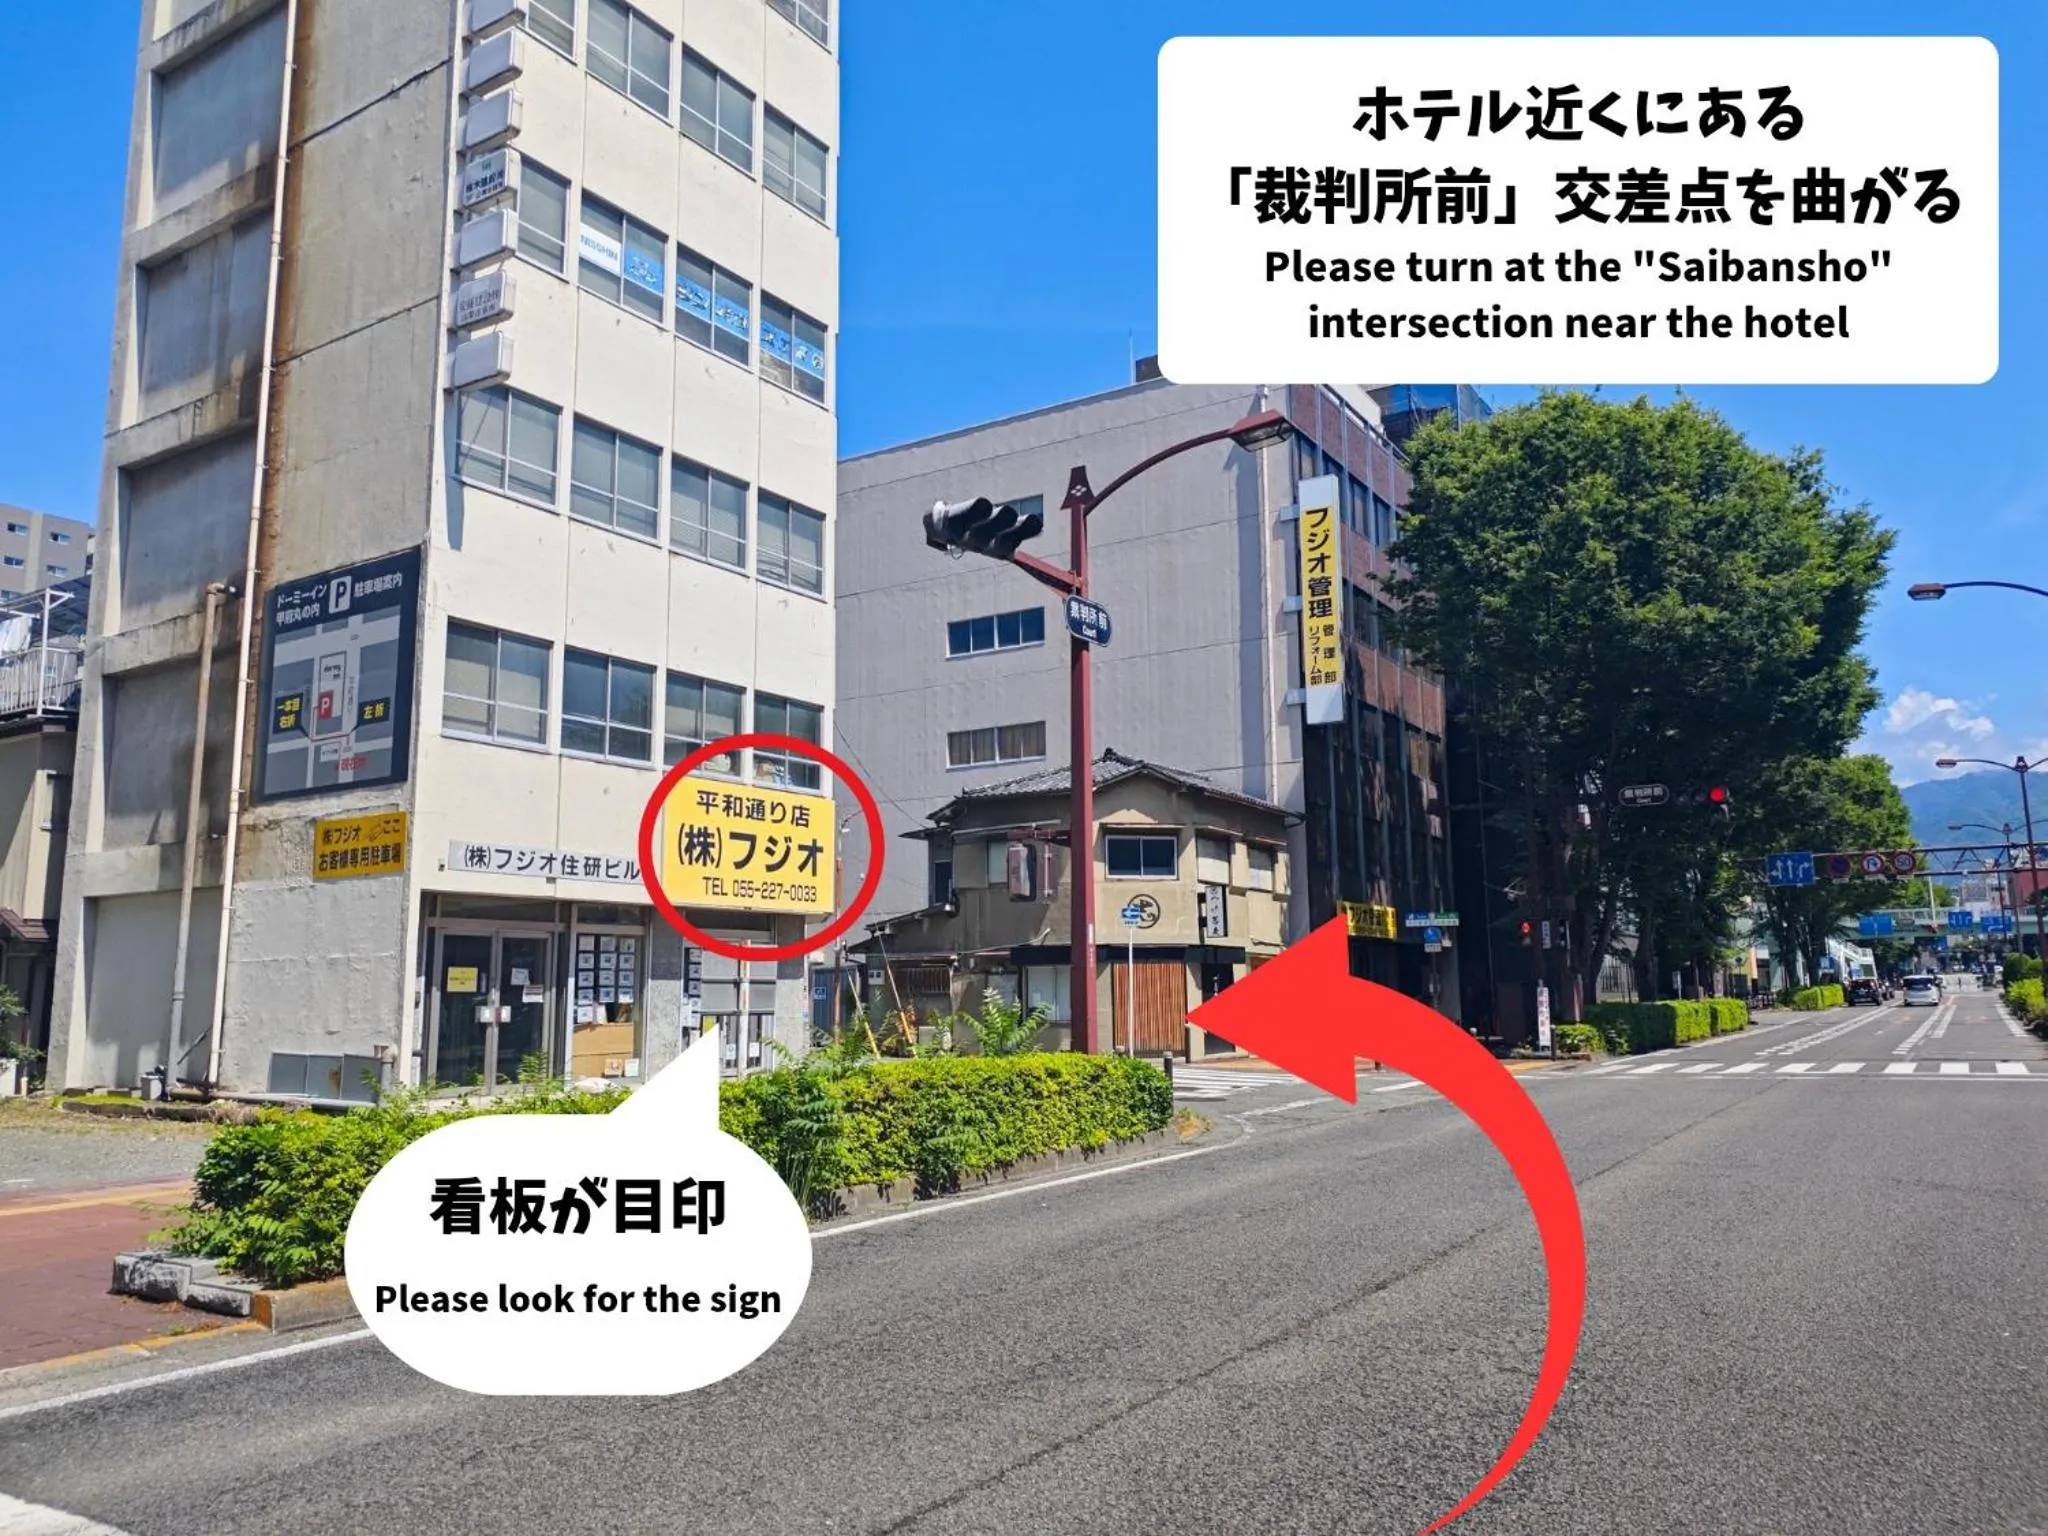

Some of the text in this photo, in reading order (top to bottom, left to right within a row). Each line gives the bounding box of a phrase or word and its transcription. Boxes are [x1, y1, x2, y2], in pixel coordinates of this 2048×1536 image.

[1305, 507, 1333, 618] フジオ管理
[276, 584, 328, 607] ドーミーイン
[354, 571, 402, 597] 駐車場案内
[696, 790, 810, 828] 平和通り店
[383, 818, 400, 834] ここ
[318, 842, 401, 871] お客様専用駐車場
[464, 845, 640, 880] (株)フジオ住研ビル
[702, 876, 817, 902] TEL 055-227-0033
